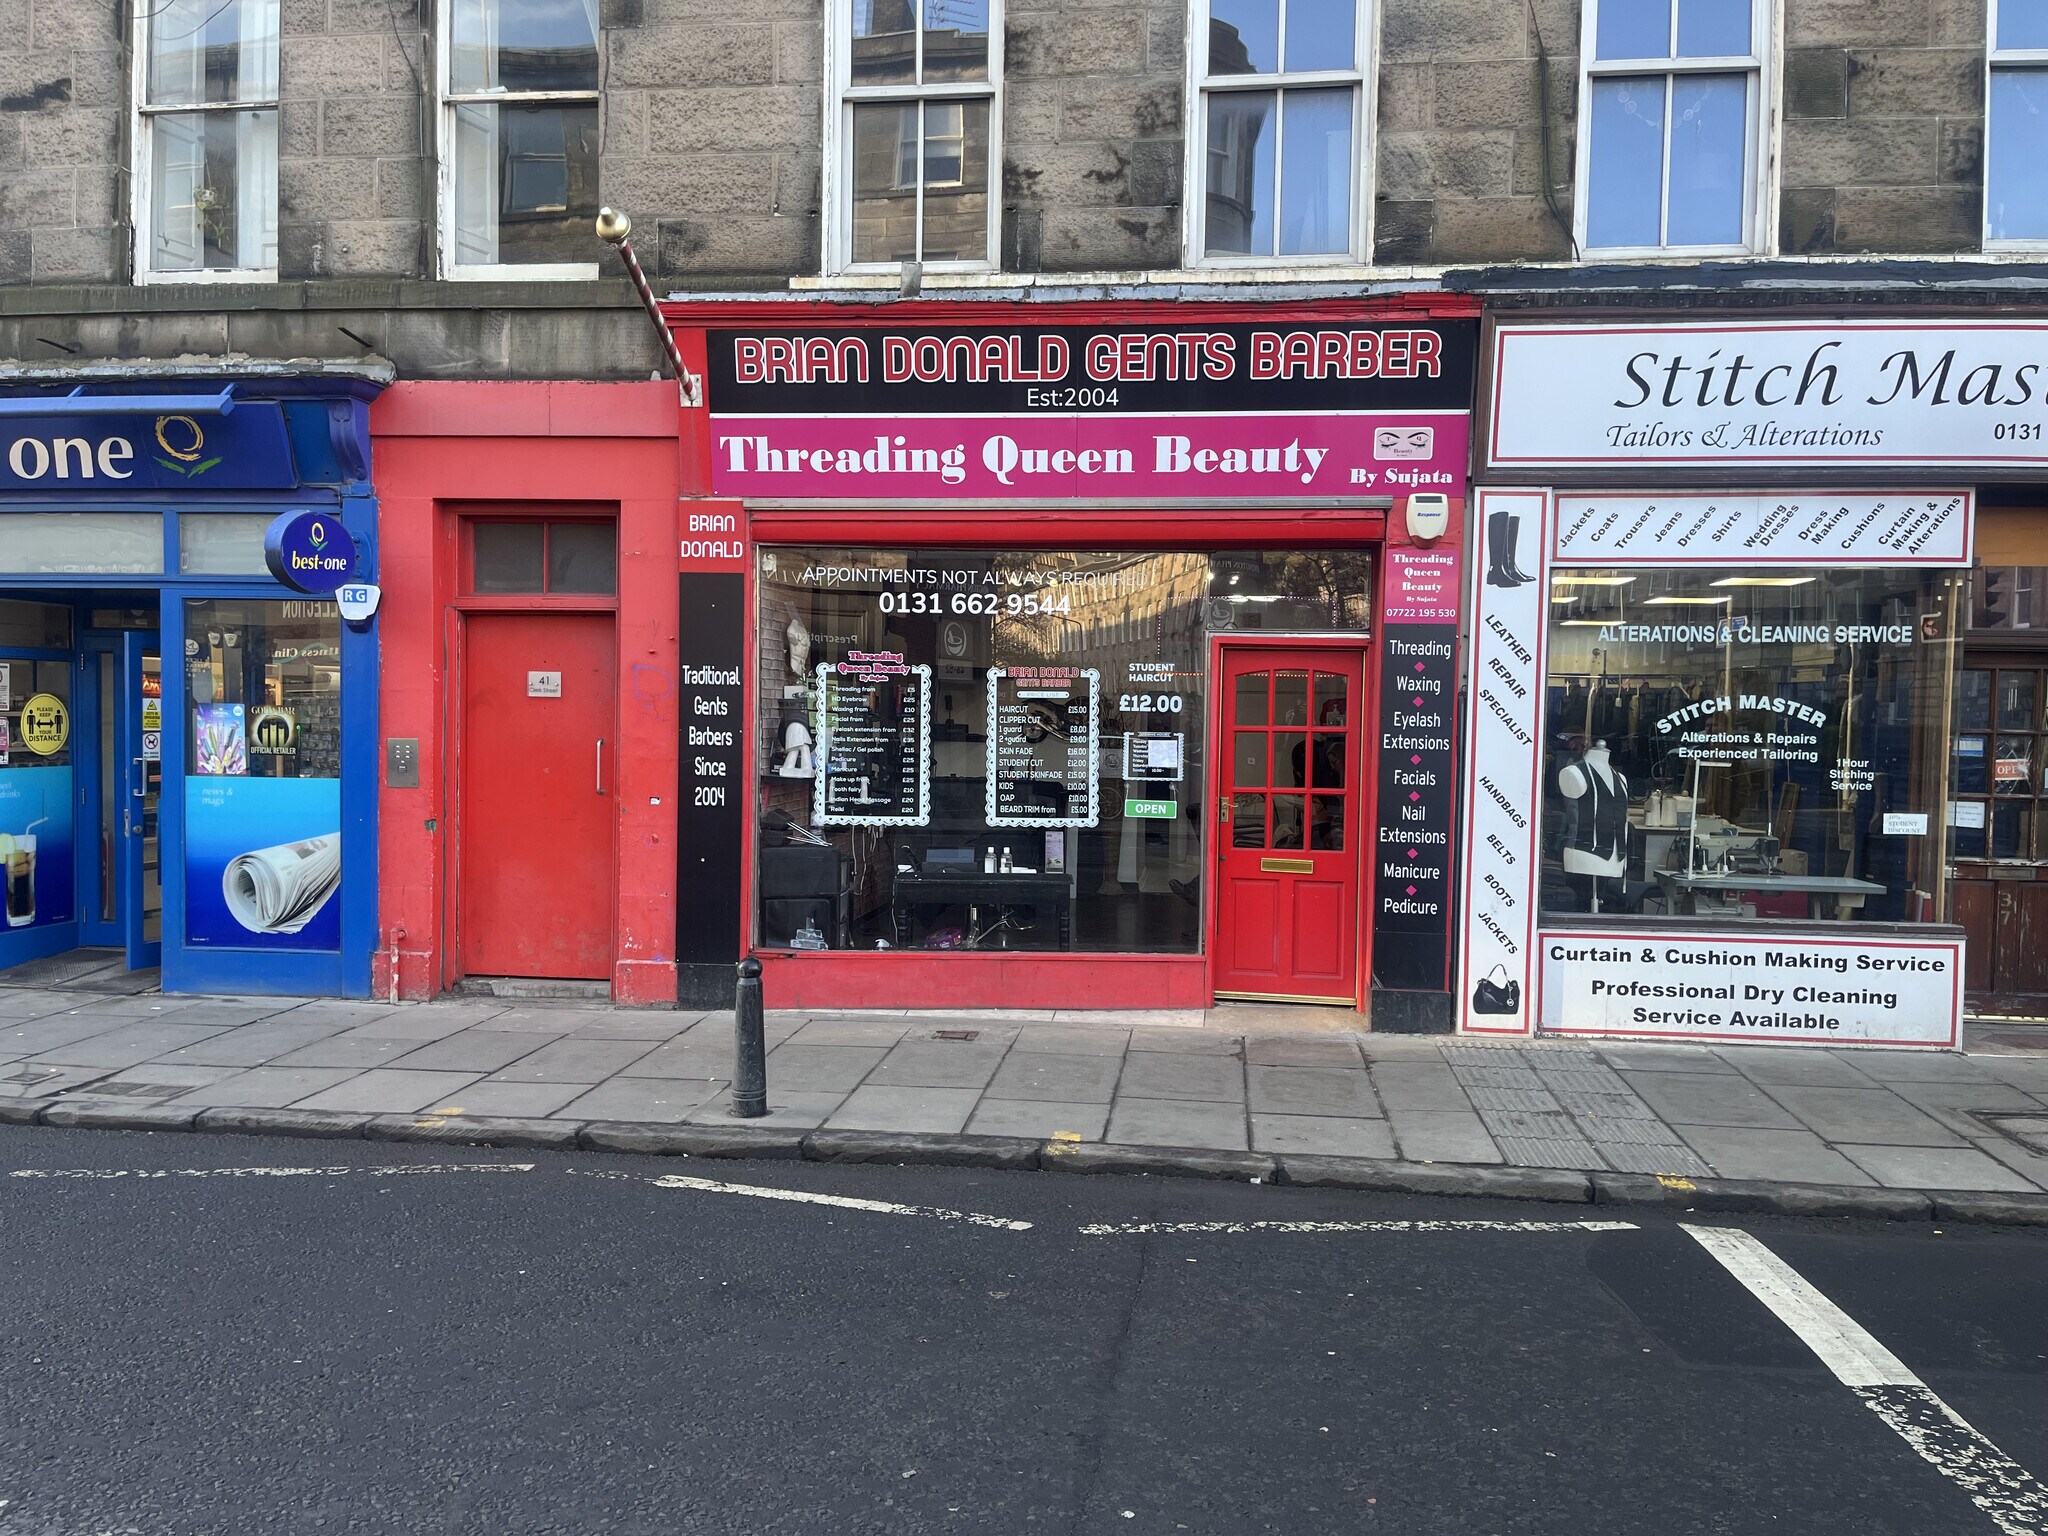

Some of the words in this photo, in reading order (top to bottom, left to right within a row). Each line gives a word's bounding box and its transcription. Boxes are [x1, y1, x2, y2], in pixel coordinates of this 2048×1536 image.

[734, 336, 870, 384] BRIAN
[883, 334, 1070, 382] DONALD
[1086, 332, 1236, 382] GENTS
[1250, 330, 1442, 380] BARBER
[1613, 342, 1843, 408] Stitch
[1866, 348, 2048, 407] Mas
[1027, 388, 1119, 406] Est:2004
[1606, 422, 1691, 448] Tailors
[1701, 426, 1727, 448] &
[1731, 422, 1884, 450] Alterations
[1994, 423, 2041, 440] 0131
[719, 436, 966, 485] Threading
[982, 435, 1134, 486] Queen
[1152, 435, 1330, 484] Beauty
[1349, 468, 1378, 488] By
[1384, 468, 1453, 488] Sujata
[689, 514, 735, 532] BRIAN
[1560, 506, 1596, 548] Jackets
[1590, 512, 1619, 542] Coats
[1614, 504, 1656, 550] Trousers
[1654, 510, 1683, 542] Jeans
[1676, 504, 1717, 548] Dresses
[1712, 510, 1742, 542] Shirts
[1742, 504, 1787, 548] Wedding
[1759, 504, 1800, 547] Dresses
[1798, 509, 1828, 541] Dress
[1811, 506, 1850, 545] Making
[1840, 502, 1886, 550] Cushions
[1878, 506, 1916, 546] Curtain
[1890, 512, 1930, 550] Making
[1928, 501, 1938, 511] &
[1908, 496, 1961, 555] Alterations
[681, 540, 744, 558] DONALD
[292, 550, 347, 570] best-one
[1392, 554, 1454, 566] Threading
[802, 566, 938, 584] APPOINTMENTS
[942, 570, 978, 585] NOT
[982, 570, 1058, 585] ALWAYS
[1062, 572, 1150, 586] REQUIRED
[1404, 568, 1441, 578] Queen
[1402, 582, 1442, 593] Beauty
[878, 592, 944, 614] 0131
[950, 592, 998, 615] 662
[1007, 594, 1071, 616] 9544
[1386, 608, 1416, 617] 07722
[1418, 609, 1436, 618] 195
[1438, 609, 1456, 618] 530
[1484, 614, 1532, 666] LEATHER
[1598, 625, 1716, 644] ALTERATIONS
[1720, 626, 1734, 642] &
[1738, 626, 1830, 644] CLEANING
[1834, 626, 1913, 644] SERVICE
[848, 650, 903, 664] Threading
[1390, 640, 1452, 660] Threading
[682, 664, 741, 686] Traditional
[838, 662, 872, 675] Queen
[872, 662, 910, 676] Beauty
[1008, 666, 1038, 678] BRIAN
[1040, 666, 1080, 678] DONALD
[1128, 663, 1175, 672] STUDENT
[539, 676, 550, 686] 41
[1128, 674, 1174, 682] HAIRCUT
[1396, 676, 1441, 696] Waxing
[1488, 657, 1526, 699] REPAIR
[694, 696, 728, 716] Gents
[1119, 694, 1182, 714] £12.00
[1656, 696, 1732, 734] STITCH
[1740, 694, 1827, 728] MASTER
[1394, 712, 1441, 730] Eyelash
[1480, 688, 1532, 746] SPECIALIST
[688, 726, 732, 746] Barbers
[1003, 726, 1022, 735] guard
[1680, 732, 1750, 744] Alterations
[1754, 733, 1763, 744] &
[1766, 732, 1817, 747] Repairs
[251, 746, 272, 754] OFFICIAL
[1383, 734, 1450, 750] Extensions
[1678, 748, 1758, 762] Experienced
[1760, 748, 1818, 764] Tailoring
[694, 756, 726, 777] Since
[1829, 770, 1875, 782] Stiching
[1394, 770, 1436, 786] Facials
[1831, 780, 1873, 791] Service
[202, 798, 224, 806] mags
[694, 786, 725, 806] 2004
[1478, 776, 1527, 829] HANDBAGS
[1134, 803, 1167, 814] OPEN
[1402, 806, 1426, 821] Nail
[1380, 828, 1446, 844] Extensions
[1486, 834, 1516, 865] BELTS
[1384, 864, 1440, 880] Manicure
[1484, 874, 1516, 908] BOOTS
[1384, 898, 1438, 915] Pedicure
[1478, 912, 1518, 955] JACKETS
[1550, 946, 1632, 964] Curtain
[1640, 948, 1656, 964] &
[1664, 948, 1756, 967] Cushion
[1764, 951, 1848, 974] Making
[1856, 954, 1946, 973] Service
[1591, 980, 1735, 1000] Professional
[1744, 985, 1785, 1006] Dry
[1792, 987, 1898, 1009] Cleaning
[1633, 1008, 1722, 1026] Service
[1728, 1011, 1840, 1030] Available
